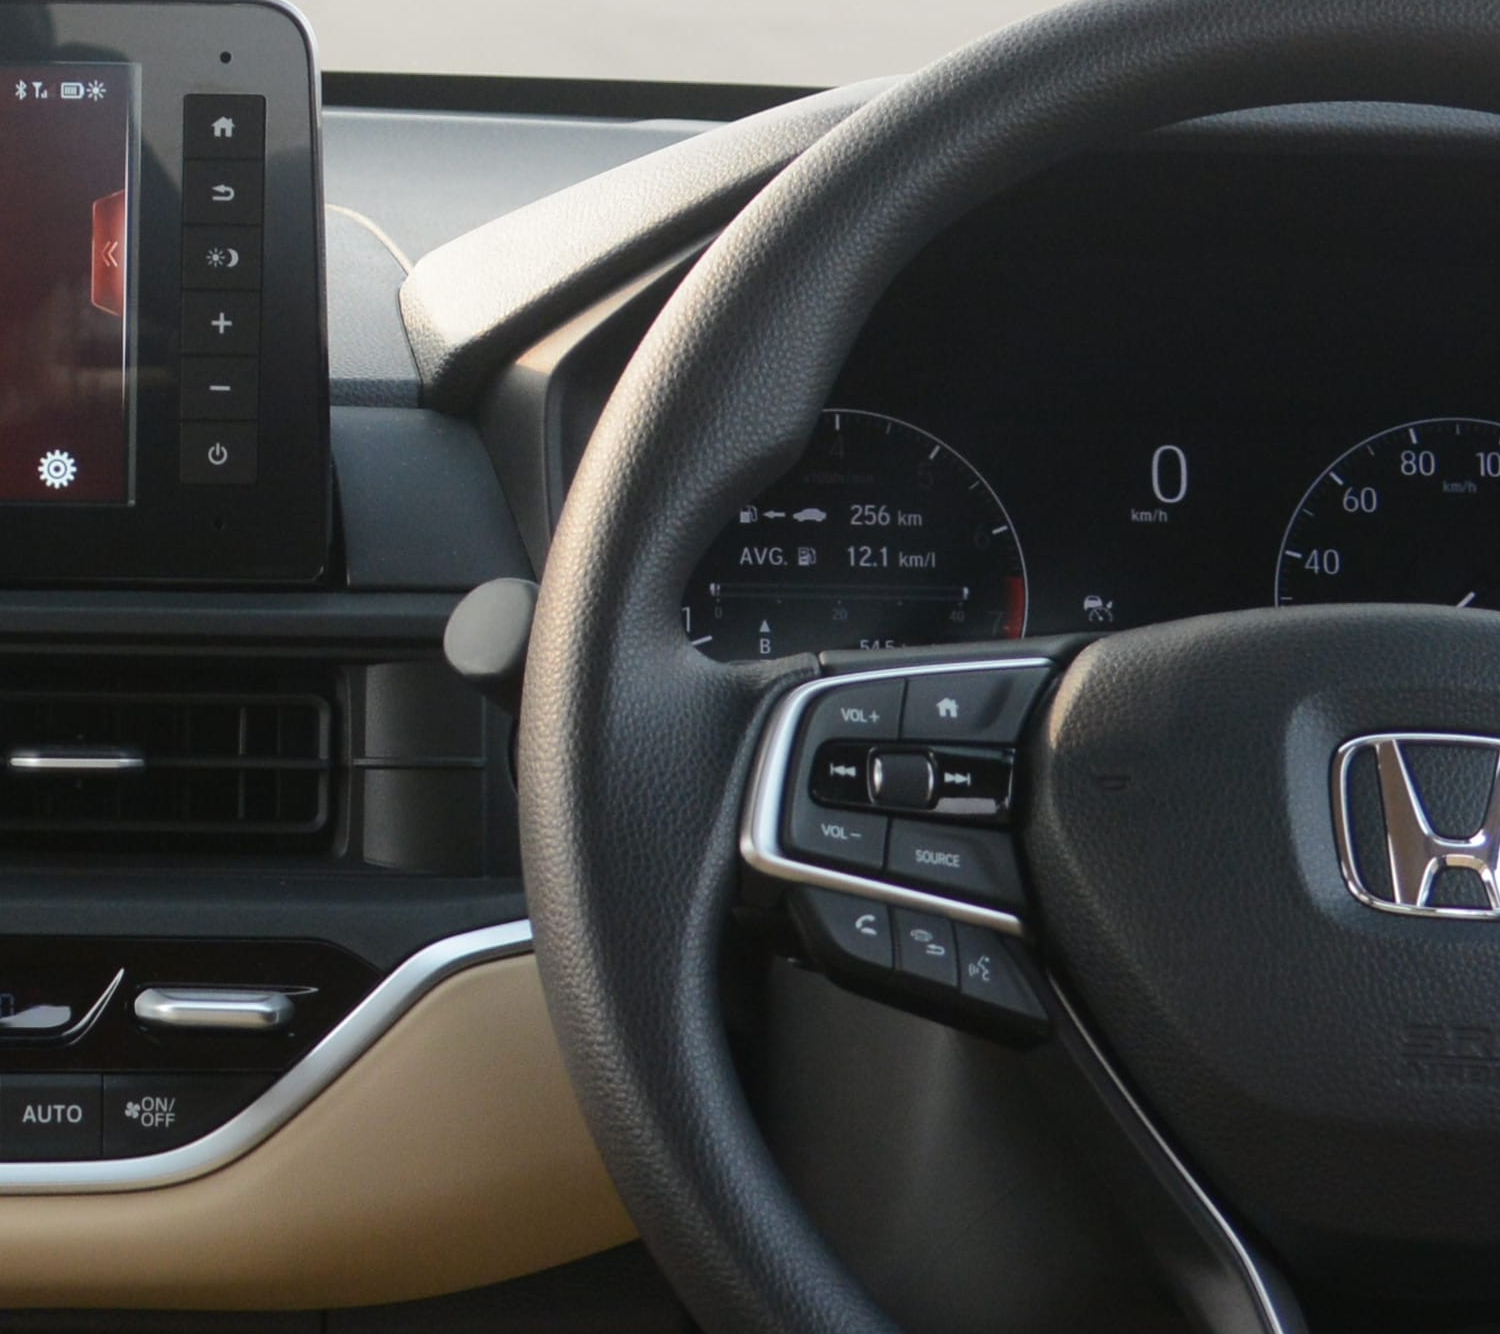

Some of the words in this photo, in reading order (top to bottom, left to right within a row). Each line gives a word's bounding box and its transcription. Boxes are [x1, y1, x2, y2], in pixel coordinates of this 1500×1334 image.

[1400, 450, 1436, 476] 80
[1151, 444, 1188, 503] 0
[1442, 480, 1478, 493] km/h
[1342, 486, 1378, 513] 60
[850, 505, 891, 526] 256
[897, 510, 923, 526] km
[1130, 508, 1168, 522] km/h
[740, 547, 788, 565] AVG.
[847, 546, 889, 567] 12.1
[898, 551, 936, 568] km/l
[1304, 549, 1340, 575] 40
[759, 639, 771, 654] B
[915, 849, 960, 867] SOURCE
[141, 1097, 175, 1112] ON/
[22, 1105, 83, 1124] AUTO
[141, 1113, 175, 1127] OFF
